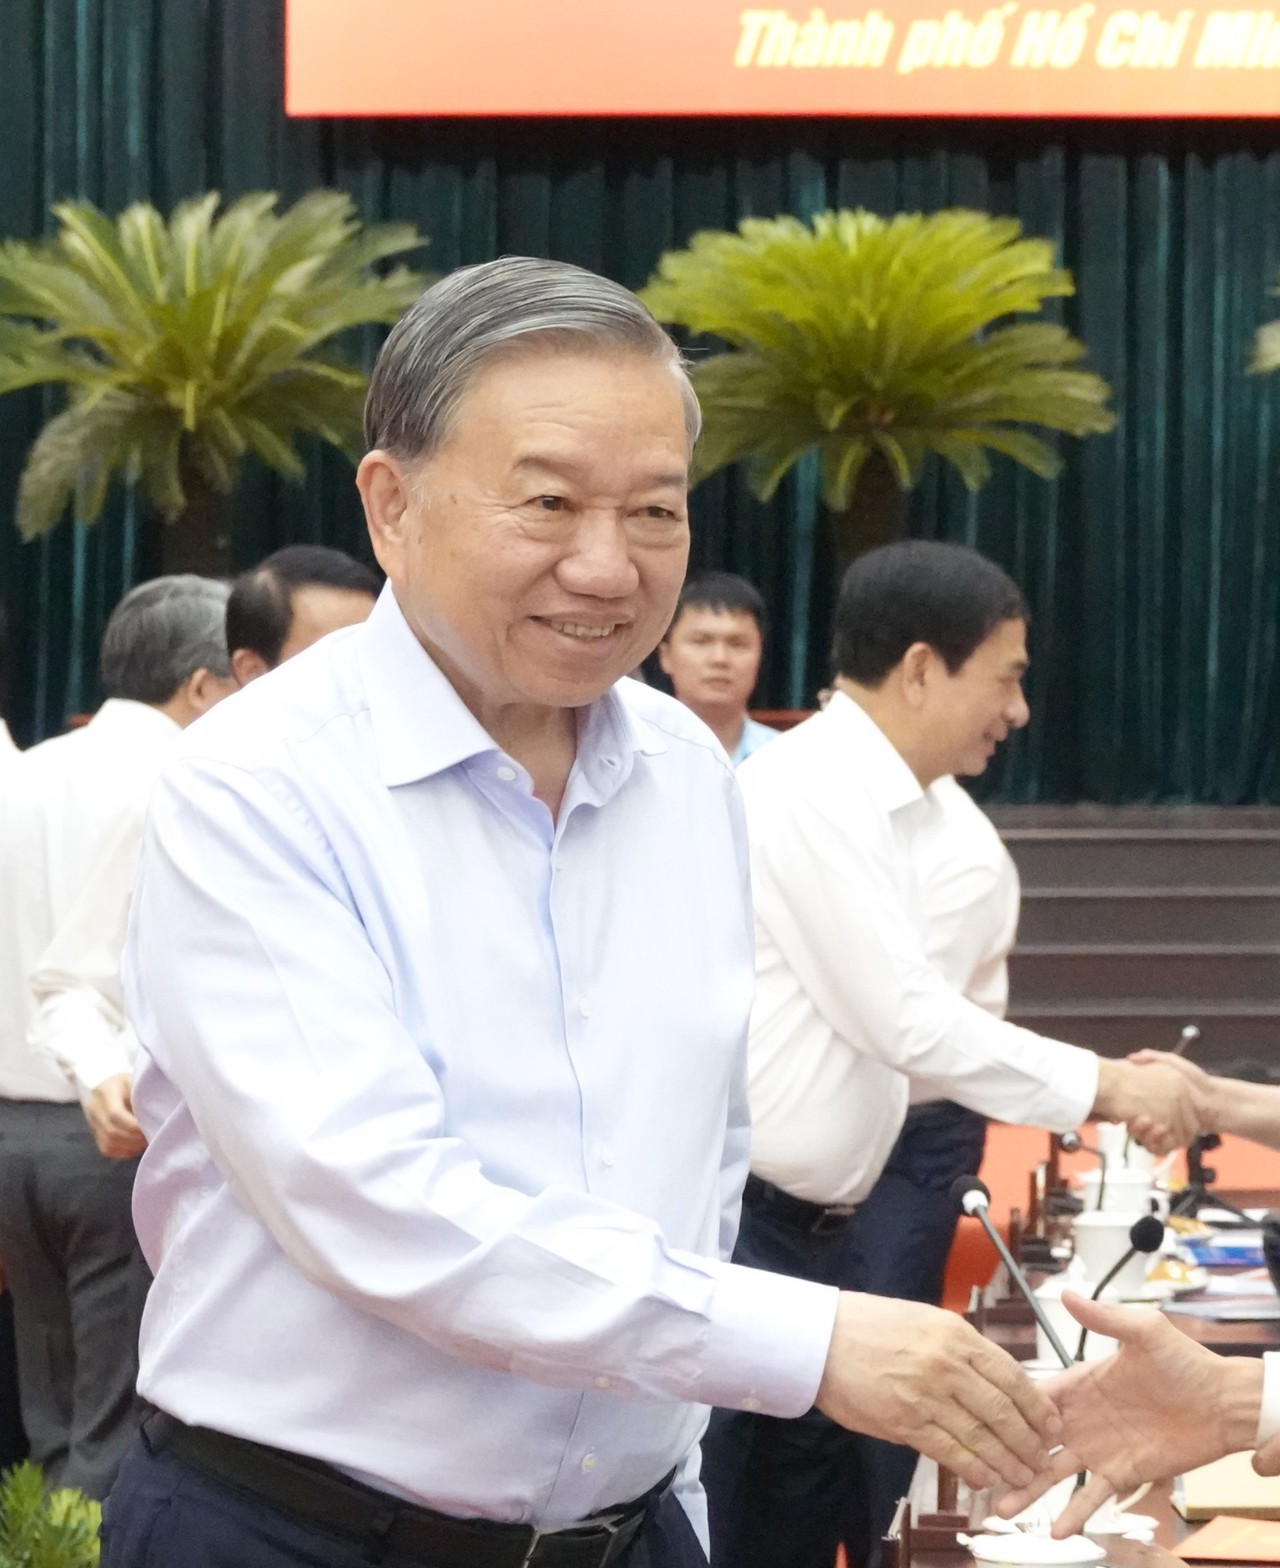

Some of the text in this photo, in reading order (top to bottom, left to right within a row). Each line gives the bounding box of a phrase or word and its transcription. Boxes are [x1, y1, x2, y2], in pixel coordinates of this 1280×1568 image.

[734, 9, 895, 67] Thành
[897, 1, 1018, 73] phố
[1095, 9, 1194, 68] Chí
